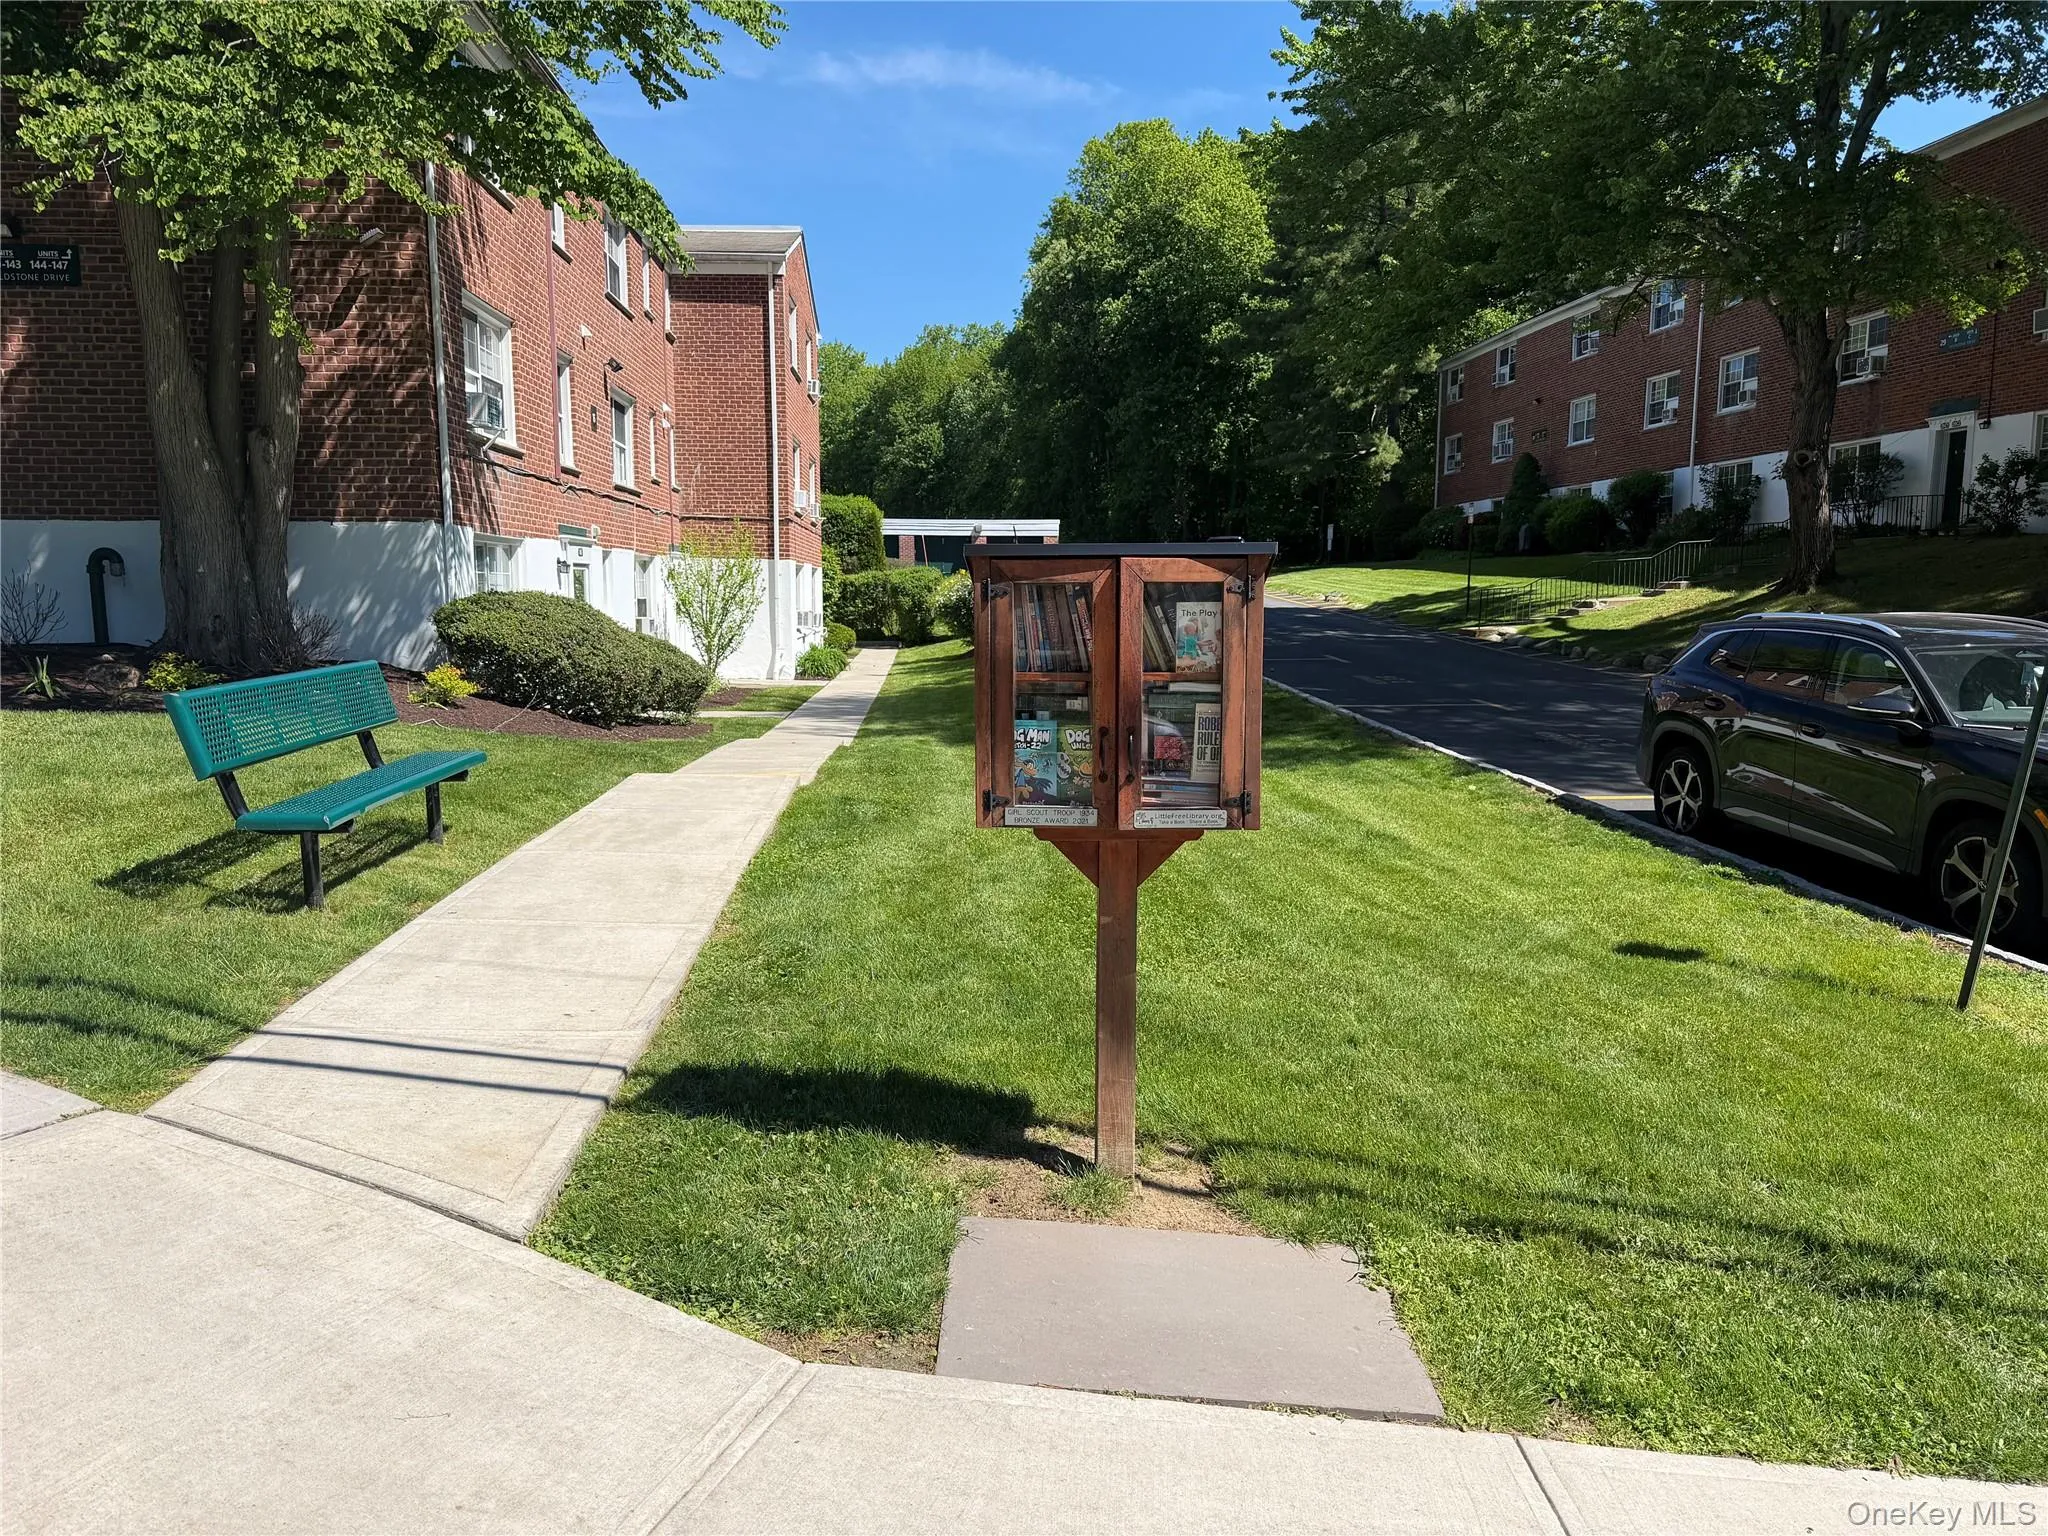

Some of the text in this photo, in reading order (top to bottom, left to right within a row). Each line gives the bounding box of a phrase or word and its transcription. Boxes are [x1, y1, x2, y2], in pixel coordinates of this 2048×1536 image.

[29, 260, 69, 270] 144-147
[43, 274, 70, 282] DRIVE
[1199, 609, 1217, 618] Play
[1027, 728, 1050, 743] MAN
[1065, 729, 1090, 743] DOG
[1197, 746, 1208, 761] OF
